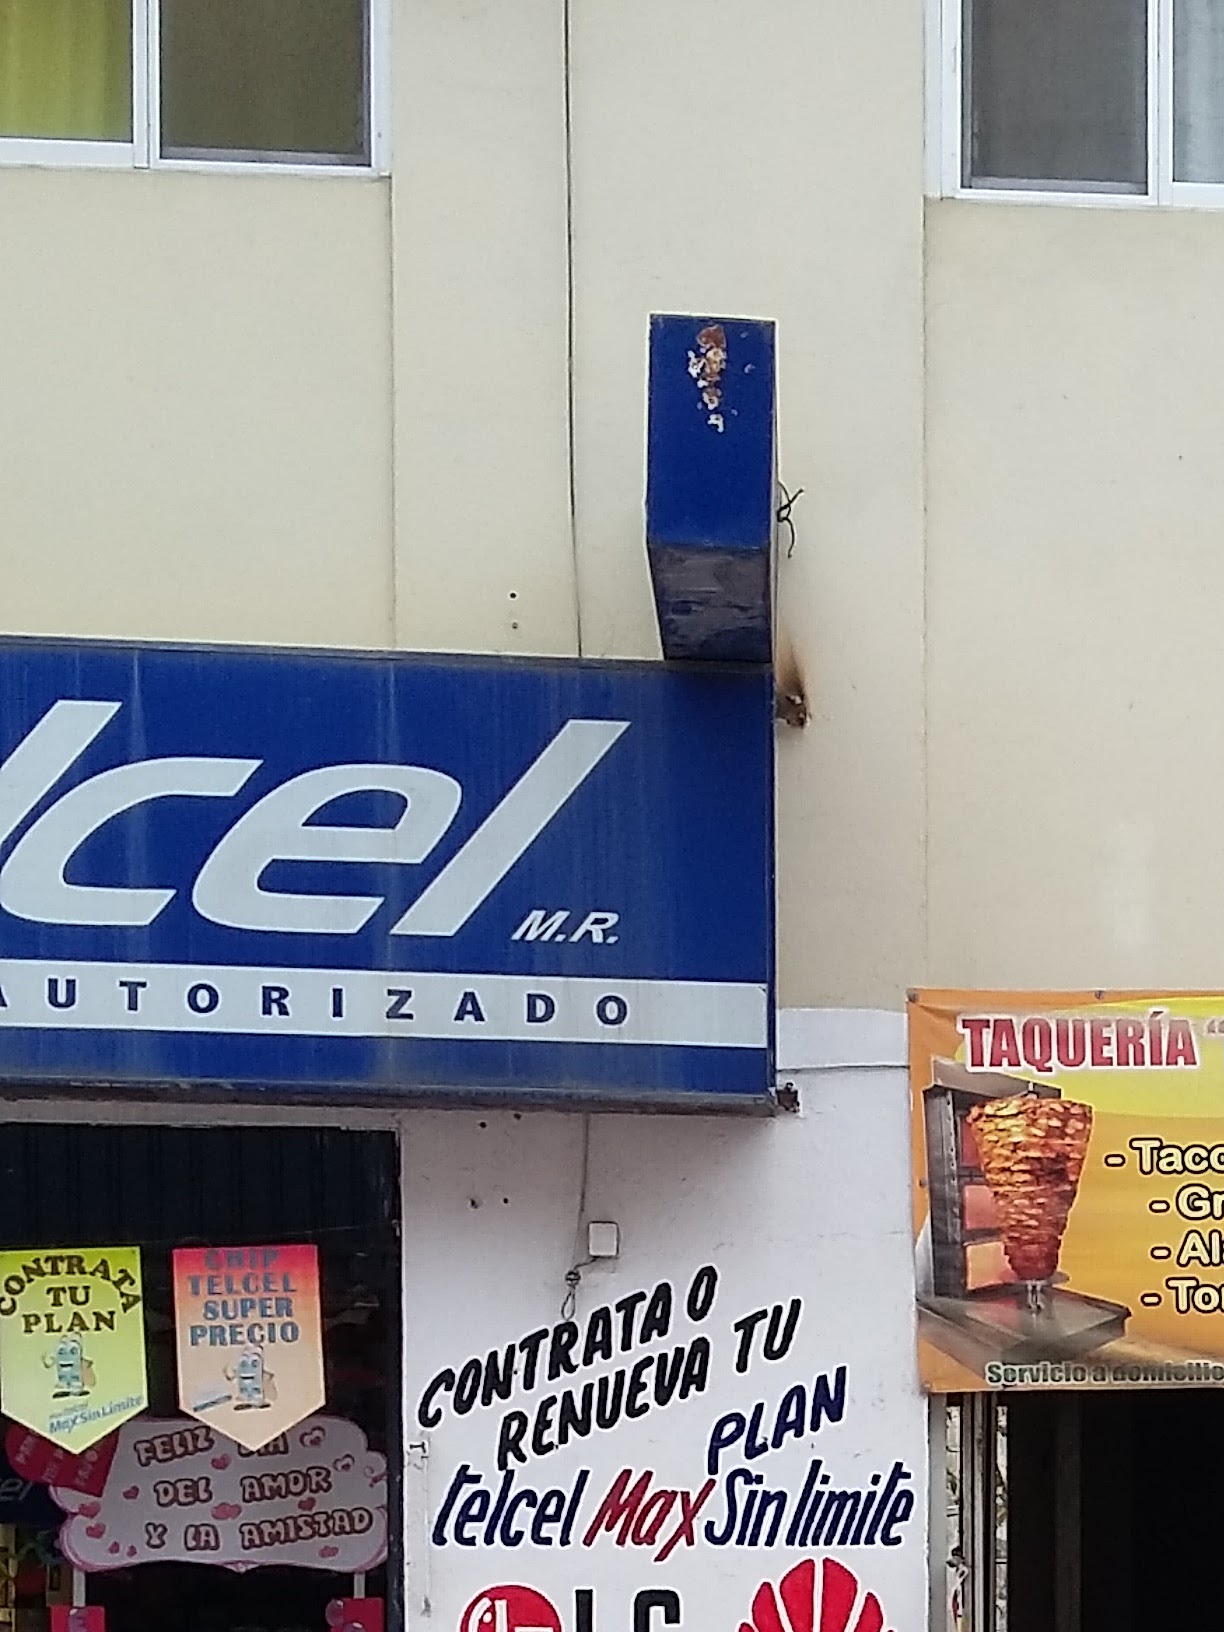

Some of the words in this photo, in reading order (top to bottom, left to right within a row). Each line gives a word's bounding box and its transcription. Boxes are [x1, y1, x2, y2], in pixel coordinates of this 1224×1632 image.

[512, 910, 620, 944] M.R.
[0, 977, 628, 1027] UTORIZADO
[962, 1010, 1197, 1072] TAQUERÍA
[204, 1247, 279, 1270] CHIP
[0, 1255, 141, 1316] CONTRATA
[46, 1286, 91, 1307] TU
[188, 1272, 298, 1295] TELCEL
[22, 1310, 116, 1333] PLAN
[203, 1296, 293, 1320] SUPER
[190, 1321, 299, 1346] PRECIO
[417, 1281, 672, 1428] CONTRATA
[686, 1265, 718, 1321] O
[497, 1336, 711, 1471] RENUEVA
[734, 1298, 802, 1372] TU
[987, 1362, 1087, 1384] Servicio
[708, 1366, 847, 1475] PLAN
[134, 1426, 214, 1467] FELIZ
[154, 1476, 213, 1507] DEL
[240, 1466, 332, 1503] AMOR
[145, 1522, 167, 1549] Y
[184, 1523, 220, 1550] LA
[239, 1507, 373, 1550] AMISTAD
